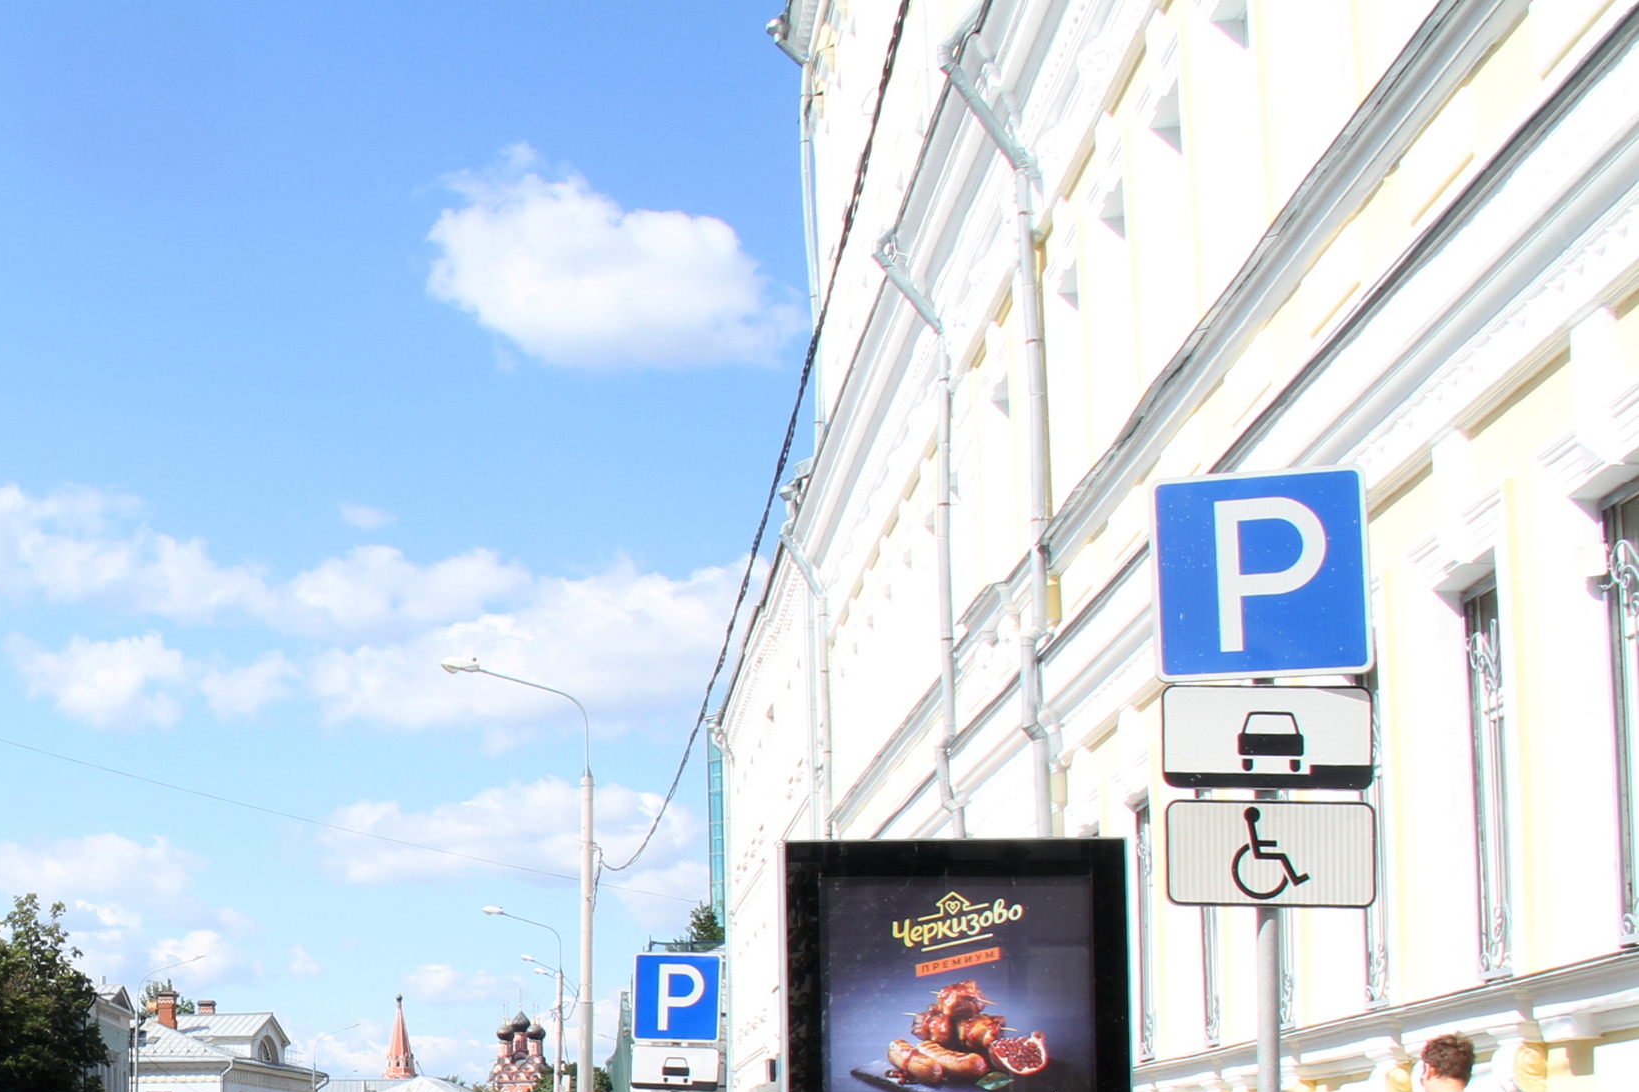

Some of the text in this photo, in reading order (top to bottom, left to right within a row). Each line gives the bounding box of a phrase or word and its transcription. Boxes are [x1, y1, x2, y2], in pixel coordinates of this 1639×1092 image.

[1213, 496, 1327, 654] P
[892, 899, 1022, 947] Черкизово
[921, 951, 995, 973] ПРЕМИУМ
[657, 964, 705, 1031] P
